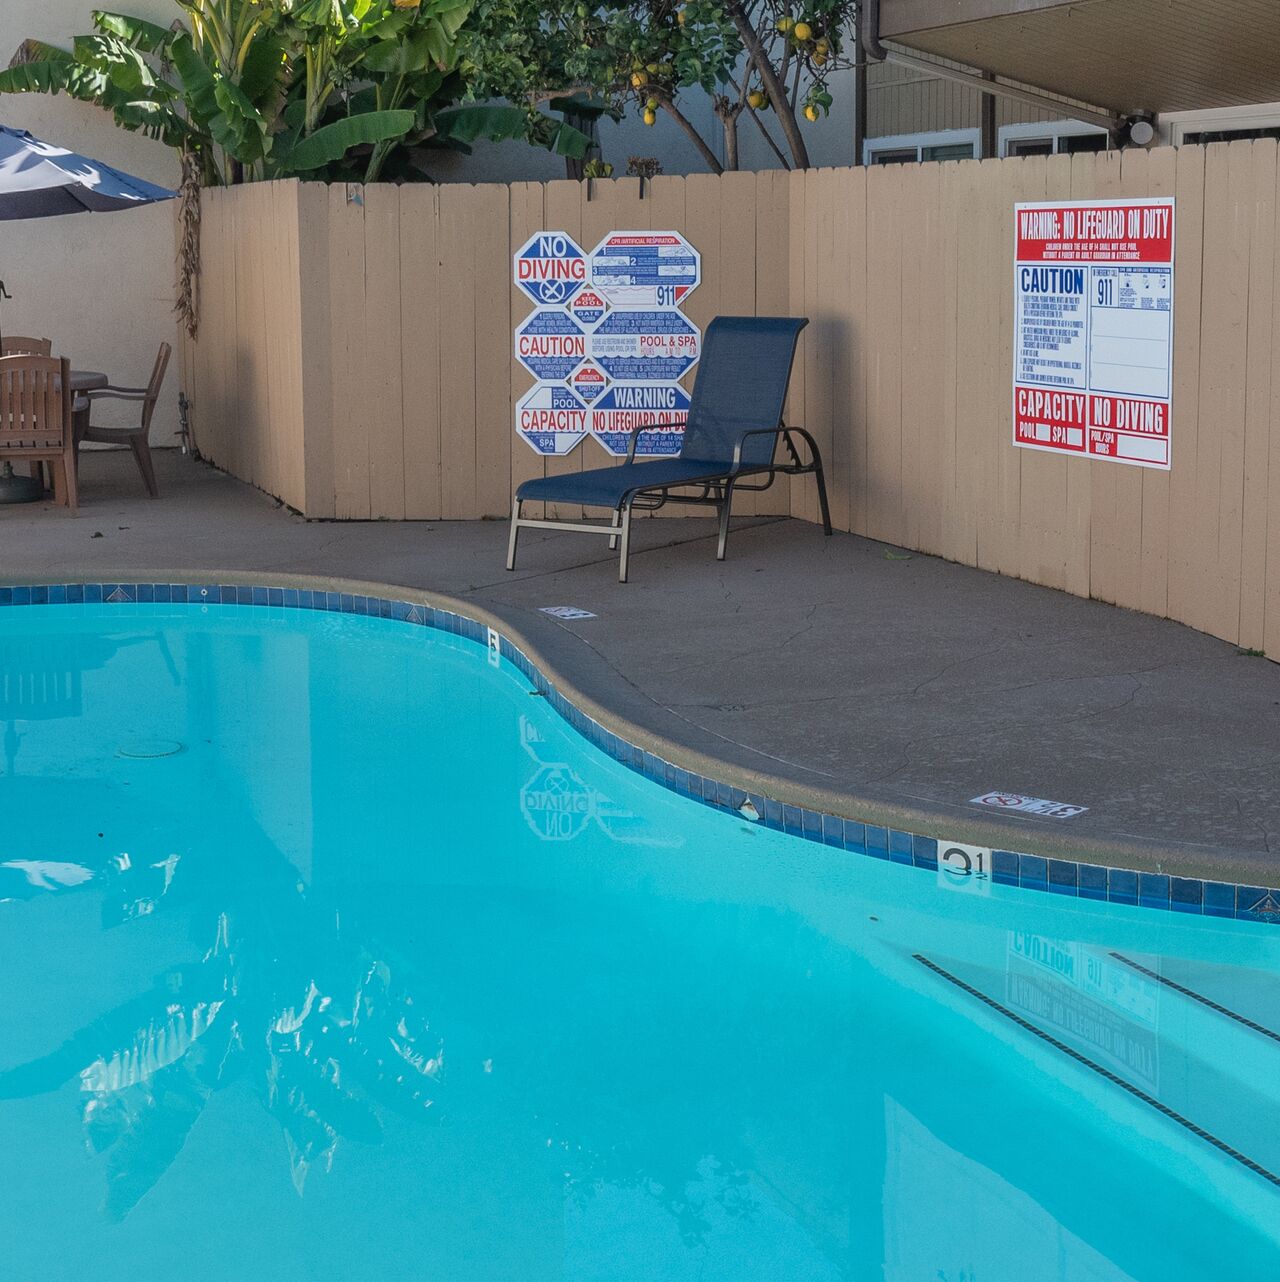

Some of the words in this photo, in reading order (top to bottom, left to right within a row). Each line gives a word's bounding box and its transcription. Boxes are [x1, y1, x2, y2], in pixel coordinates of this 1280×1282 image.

[1021, 211, 1061, 240] WARNING:
[1063, 210, 1075, 240] NO
[1077, 209, 1125, 240] LIFEGUARD
[1128, 209, 1141, 239] ON
[1143, 208, 1169, 239] DUTY
[539, 236, 567, 257] NO
[602, 247, 606, 255] 1
[519, 258, 586, 280] DIVING
[593, 267, 598, 275] 3
[630, 258, 637, 266] 2
[630, 276, 636, 285] 4
[1021, 268, 1083, 294] CAUTION
[657, 286, 675, 306] 911
[1098, 279, 1112, 305] 911
[519, 336, 585, 355] CAUTION
[640, 336, 666, 346] POOL
[669, 336, 675, 346] &
[677, 336, 696, 346] SPA
[553, 399, 579, 408] POOL
[614, 388, 676, 408] WARNING
[1019, 389, 1084, 424] CAPACITY
[521, 411, 587, 430] CAPACITY
[593, 411, 605, 431] NO
[608, 411, 656, 431] LIFEGUARD
[658, 411, 671, 431] ON
[674, 411, 689, 431] DU
[1094, 397, 1111, 426] NO
[1116, 400, 1163, 433] DIVING
[539, 438, 554, 446] SPA
[1020, 421, 1036, 440] POOL
[1052, 429, 1067, 444] SPA
